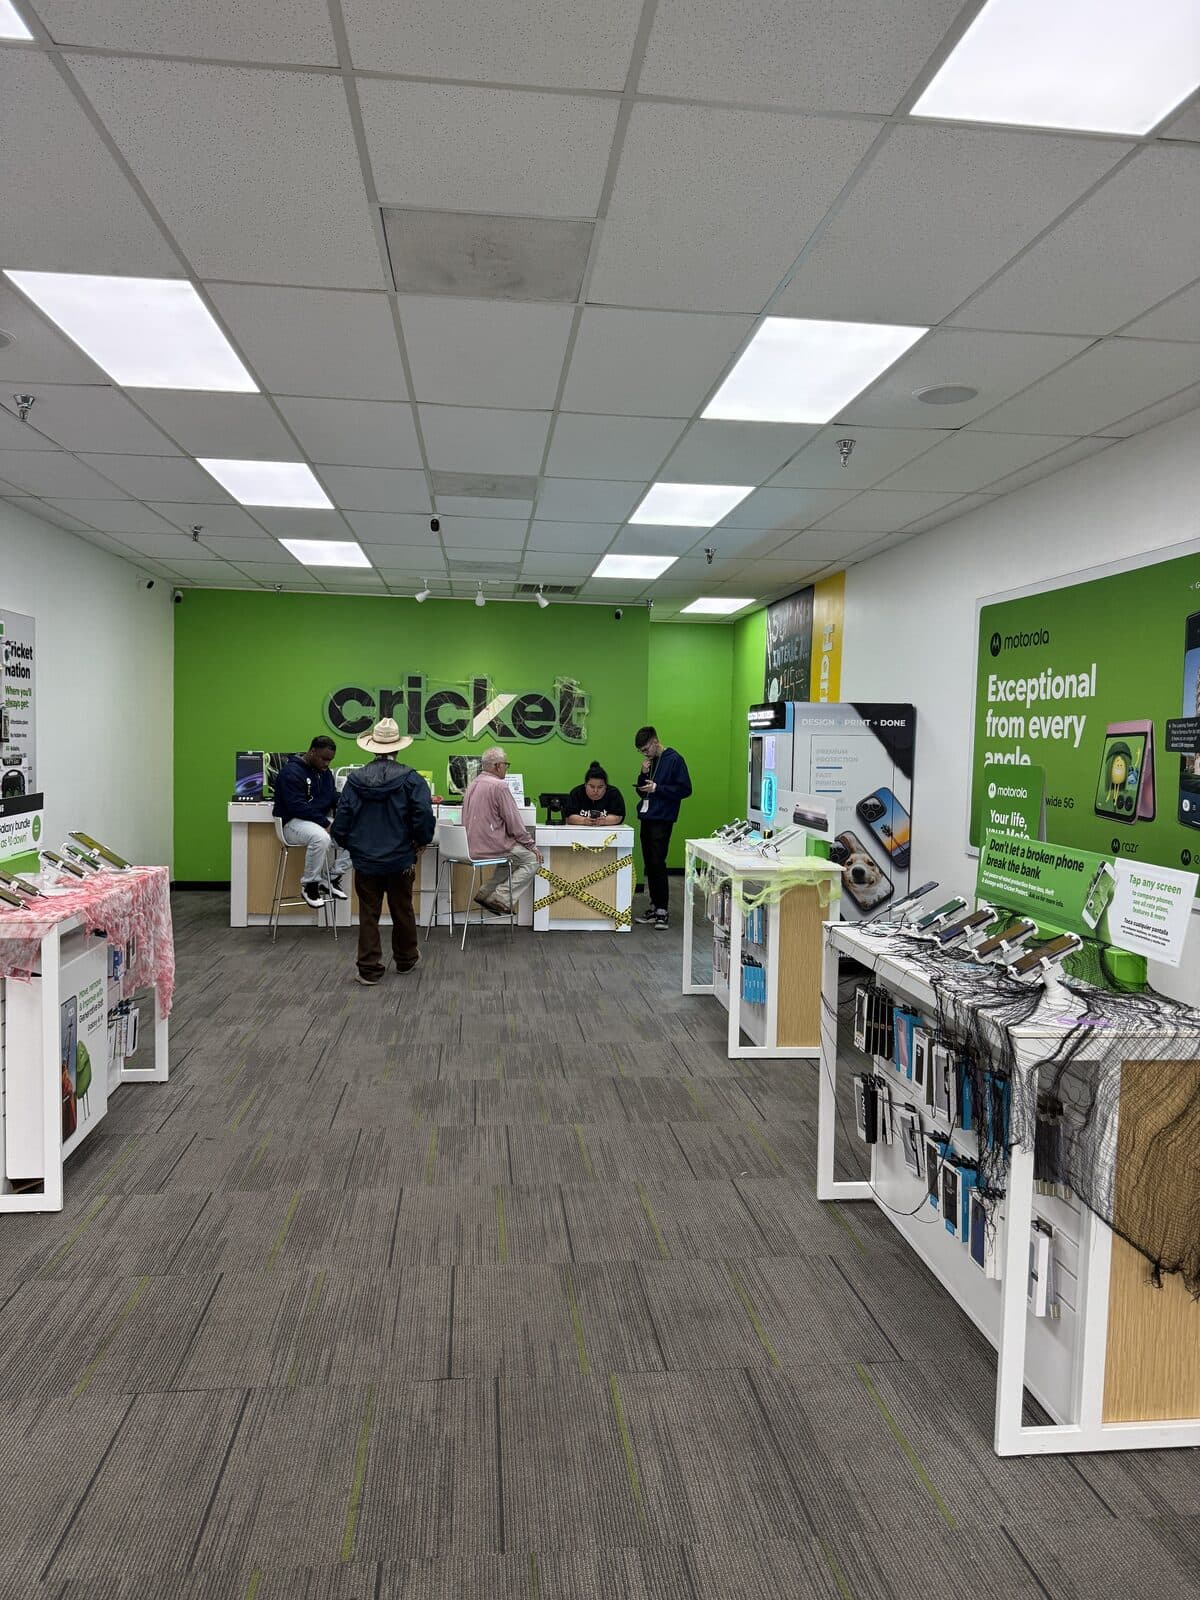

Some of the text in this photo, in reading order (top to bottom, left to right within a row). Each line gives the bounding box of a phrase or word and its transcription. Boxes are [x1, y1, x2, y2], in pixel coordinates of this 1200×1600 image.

[1004, 628, 1050, 650] motorola
[5, 640, 33, 661] ricket
[987, 663, 1097, 708] Exceptional
[327, 674, 588, 741] cricket
[801, 719, 835, 727] DESIGN
[844, 719, 871, 727] PRINT
[880, 719, 906, 727] DONE
[986, 708, 1087, 748] from every
[997, 786, 1028, 799] motorola
[1063, 797, 1075, 809] 5G
[990, 809, 1028, 831] Your life,
[989, 839, 1084, 872] Don't let a broken phone
[1121, 841, 1139, 853] razr
[986, 854, 1041, 879] break the bank
[1129, 874, 1182, 895] Tap any screen
